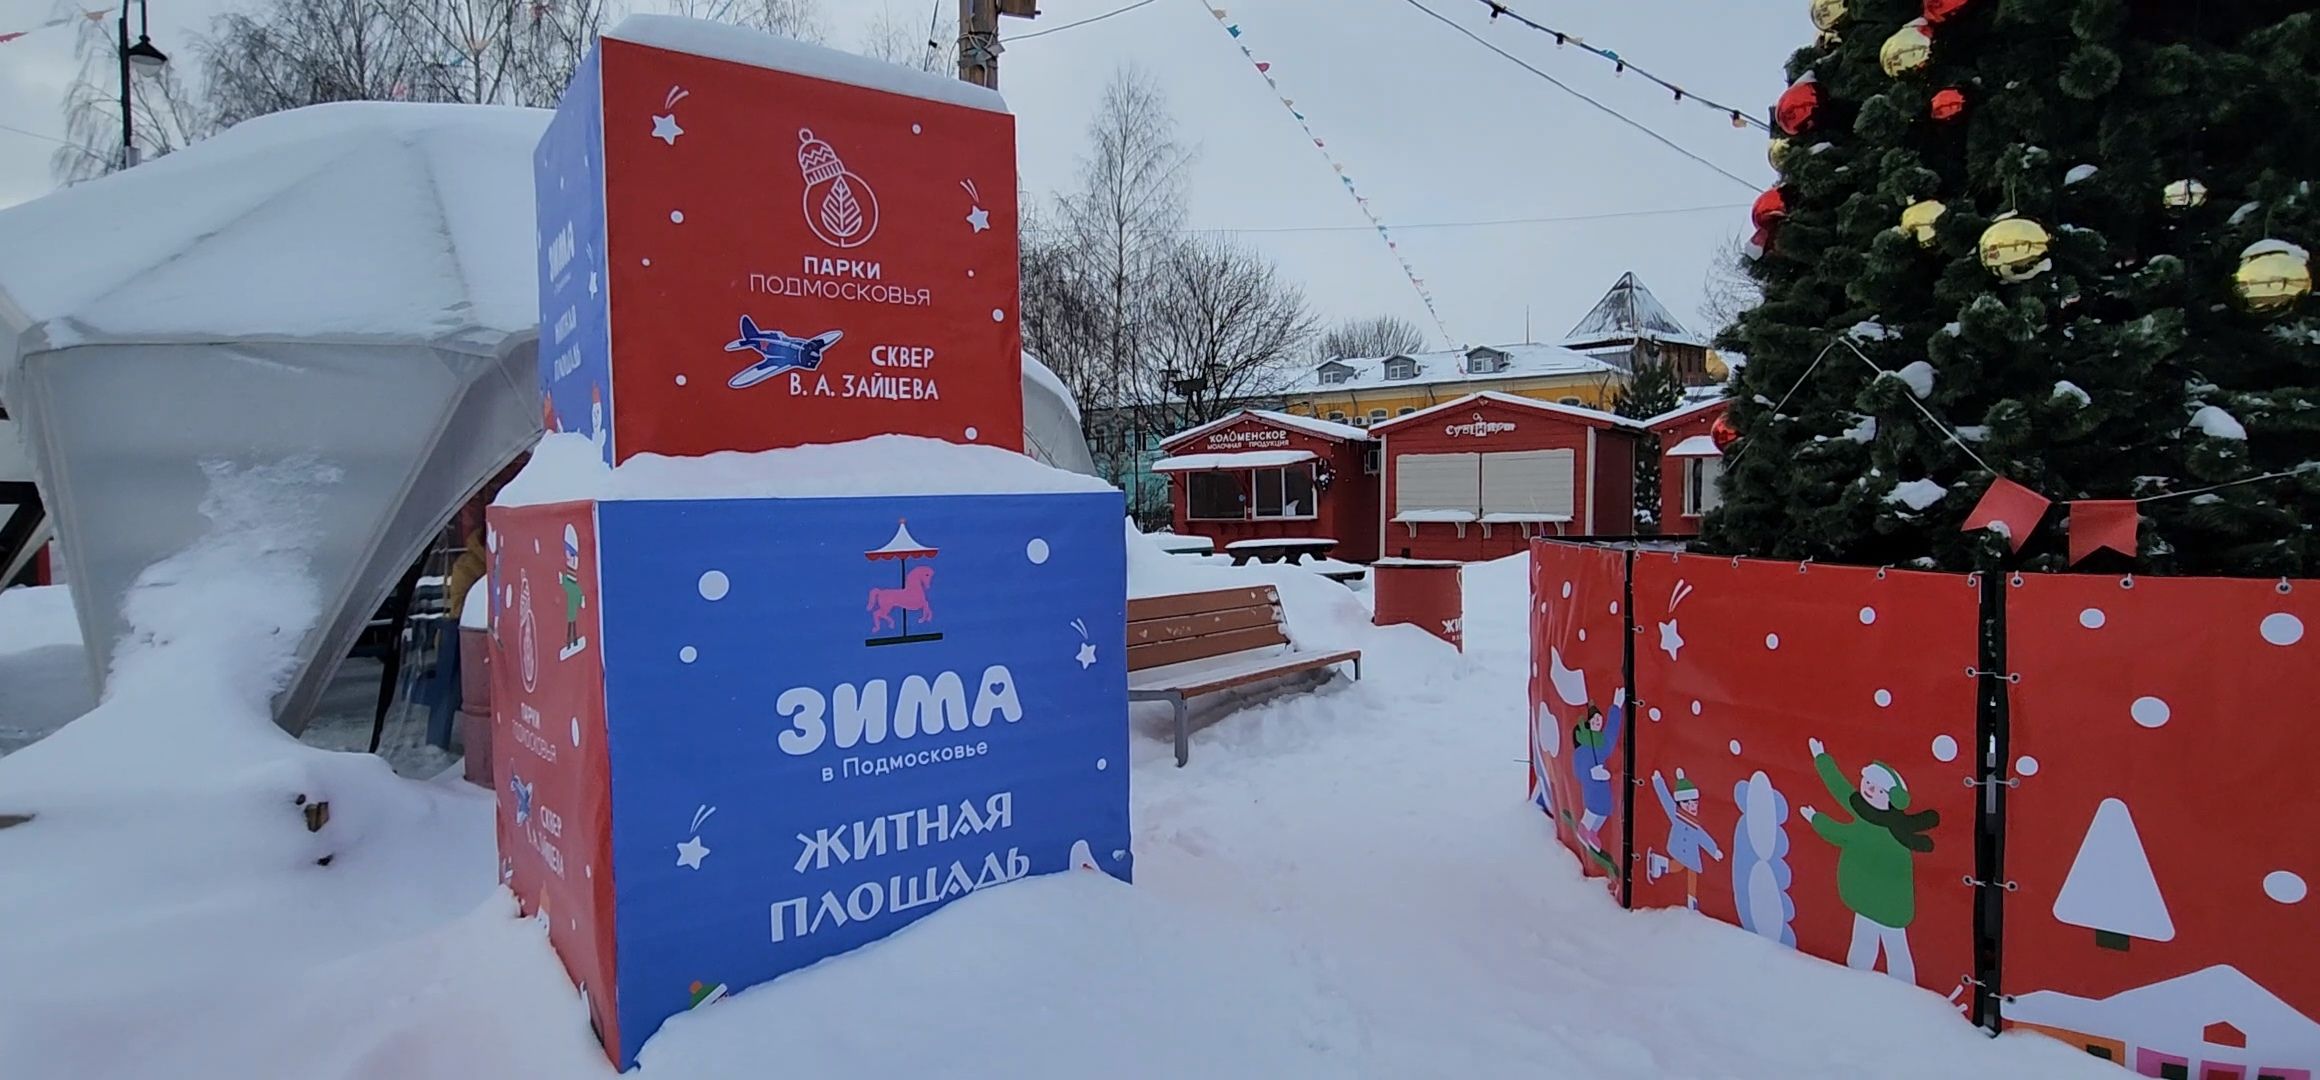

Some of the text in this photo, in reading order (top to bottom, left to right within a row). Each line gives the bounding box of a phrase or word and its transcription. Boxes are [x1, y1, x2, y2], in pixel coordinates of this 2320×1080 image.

[804, 256, 881, 280] ПАРКИ
[750, 274, 931, 306] ПОДМОСКОВЬЯ
[871, 345, 935, 369] СКВЕР
[790, 373, 939, 400] В. А. ЗАЙЦЕВА
[1209, 430, 1287, 443] КОЛОМЕНСКОЕ
[776, 665, 1023, 756] ЗИМА
[821, 741, 988, 782] в Подмосковье
[793, 792, 1012, 874] ЖИТНАЯ
[770, 847, 1030, 943] ПЛОЩАДЬ
